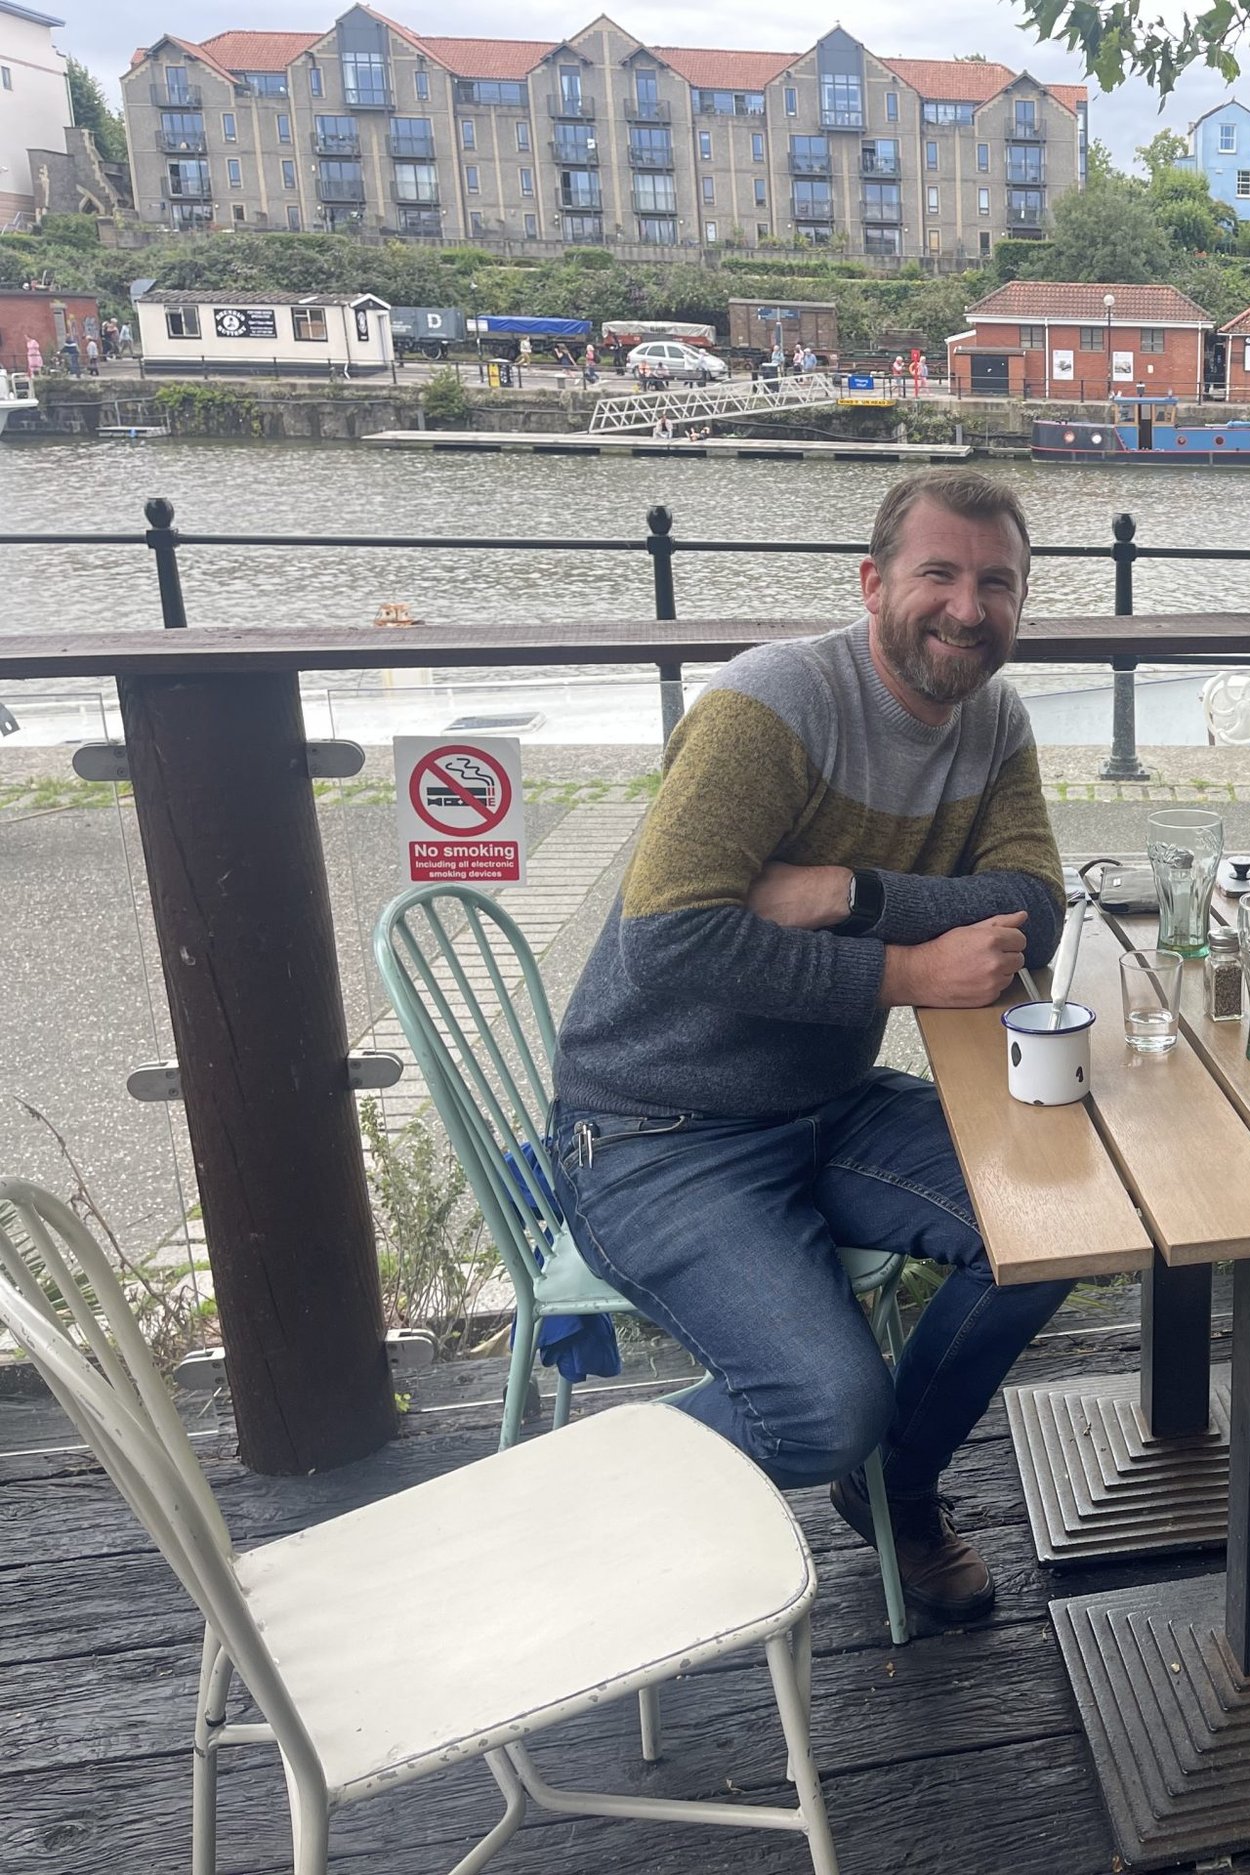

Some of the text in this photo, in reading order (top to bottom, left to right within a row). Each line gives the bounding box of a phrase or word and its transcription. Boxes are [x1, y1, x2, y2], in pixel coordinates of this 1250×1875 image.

[427, 313, 442, 329] D
[414, 844, 514, 859] No smoking
[415, 860, 514, 869] Including all electronic
[429, 870, 502, 878] smoking devices
